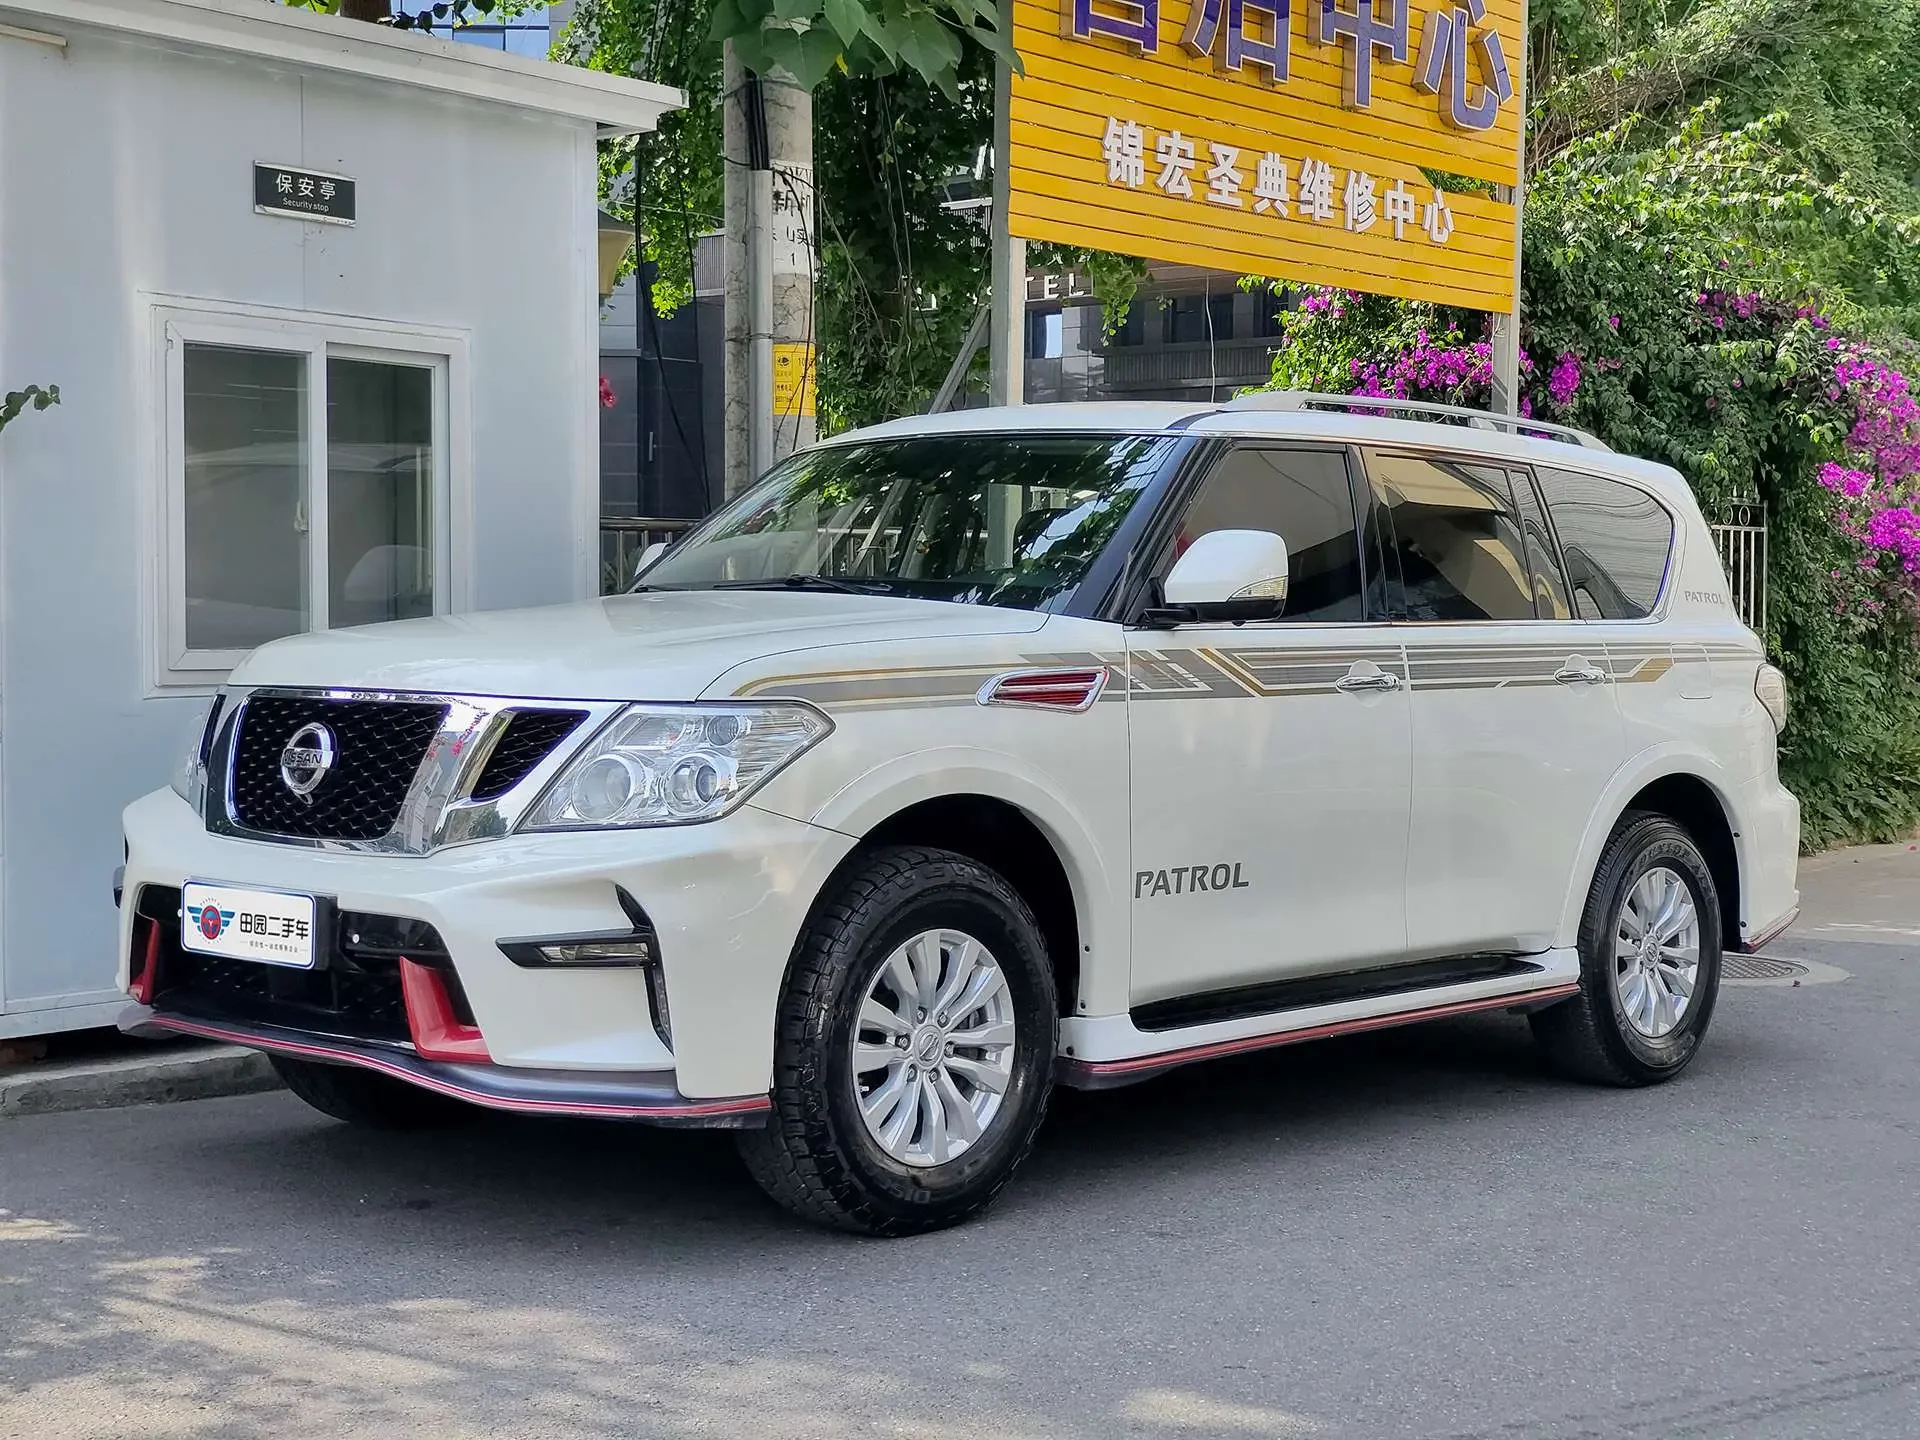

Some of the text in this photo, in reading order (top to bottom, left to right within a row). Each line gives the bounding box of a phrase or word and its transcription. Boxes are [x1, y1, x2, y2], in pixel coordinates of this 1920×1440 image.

[276, 173, 336, 200] 保安亭
[1102, 116, 1455, 244] 锦宏圣典维修中心
[283, 197, 329, 212] Security stop
[1684, 591, 1725, 605] PATROL
[1134, 862, 1249, 899] PATROL
[240, 912, 309, 939] 田园二手车
